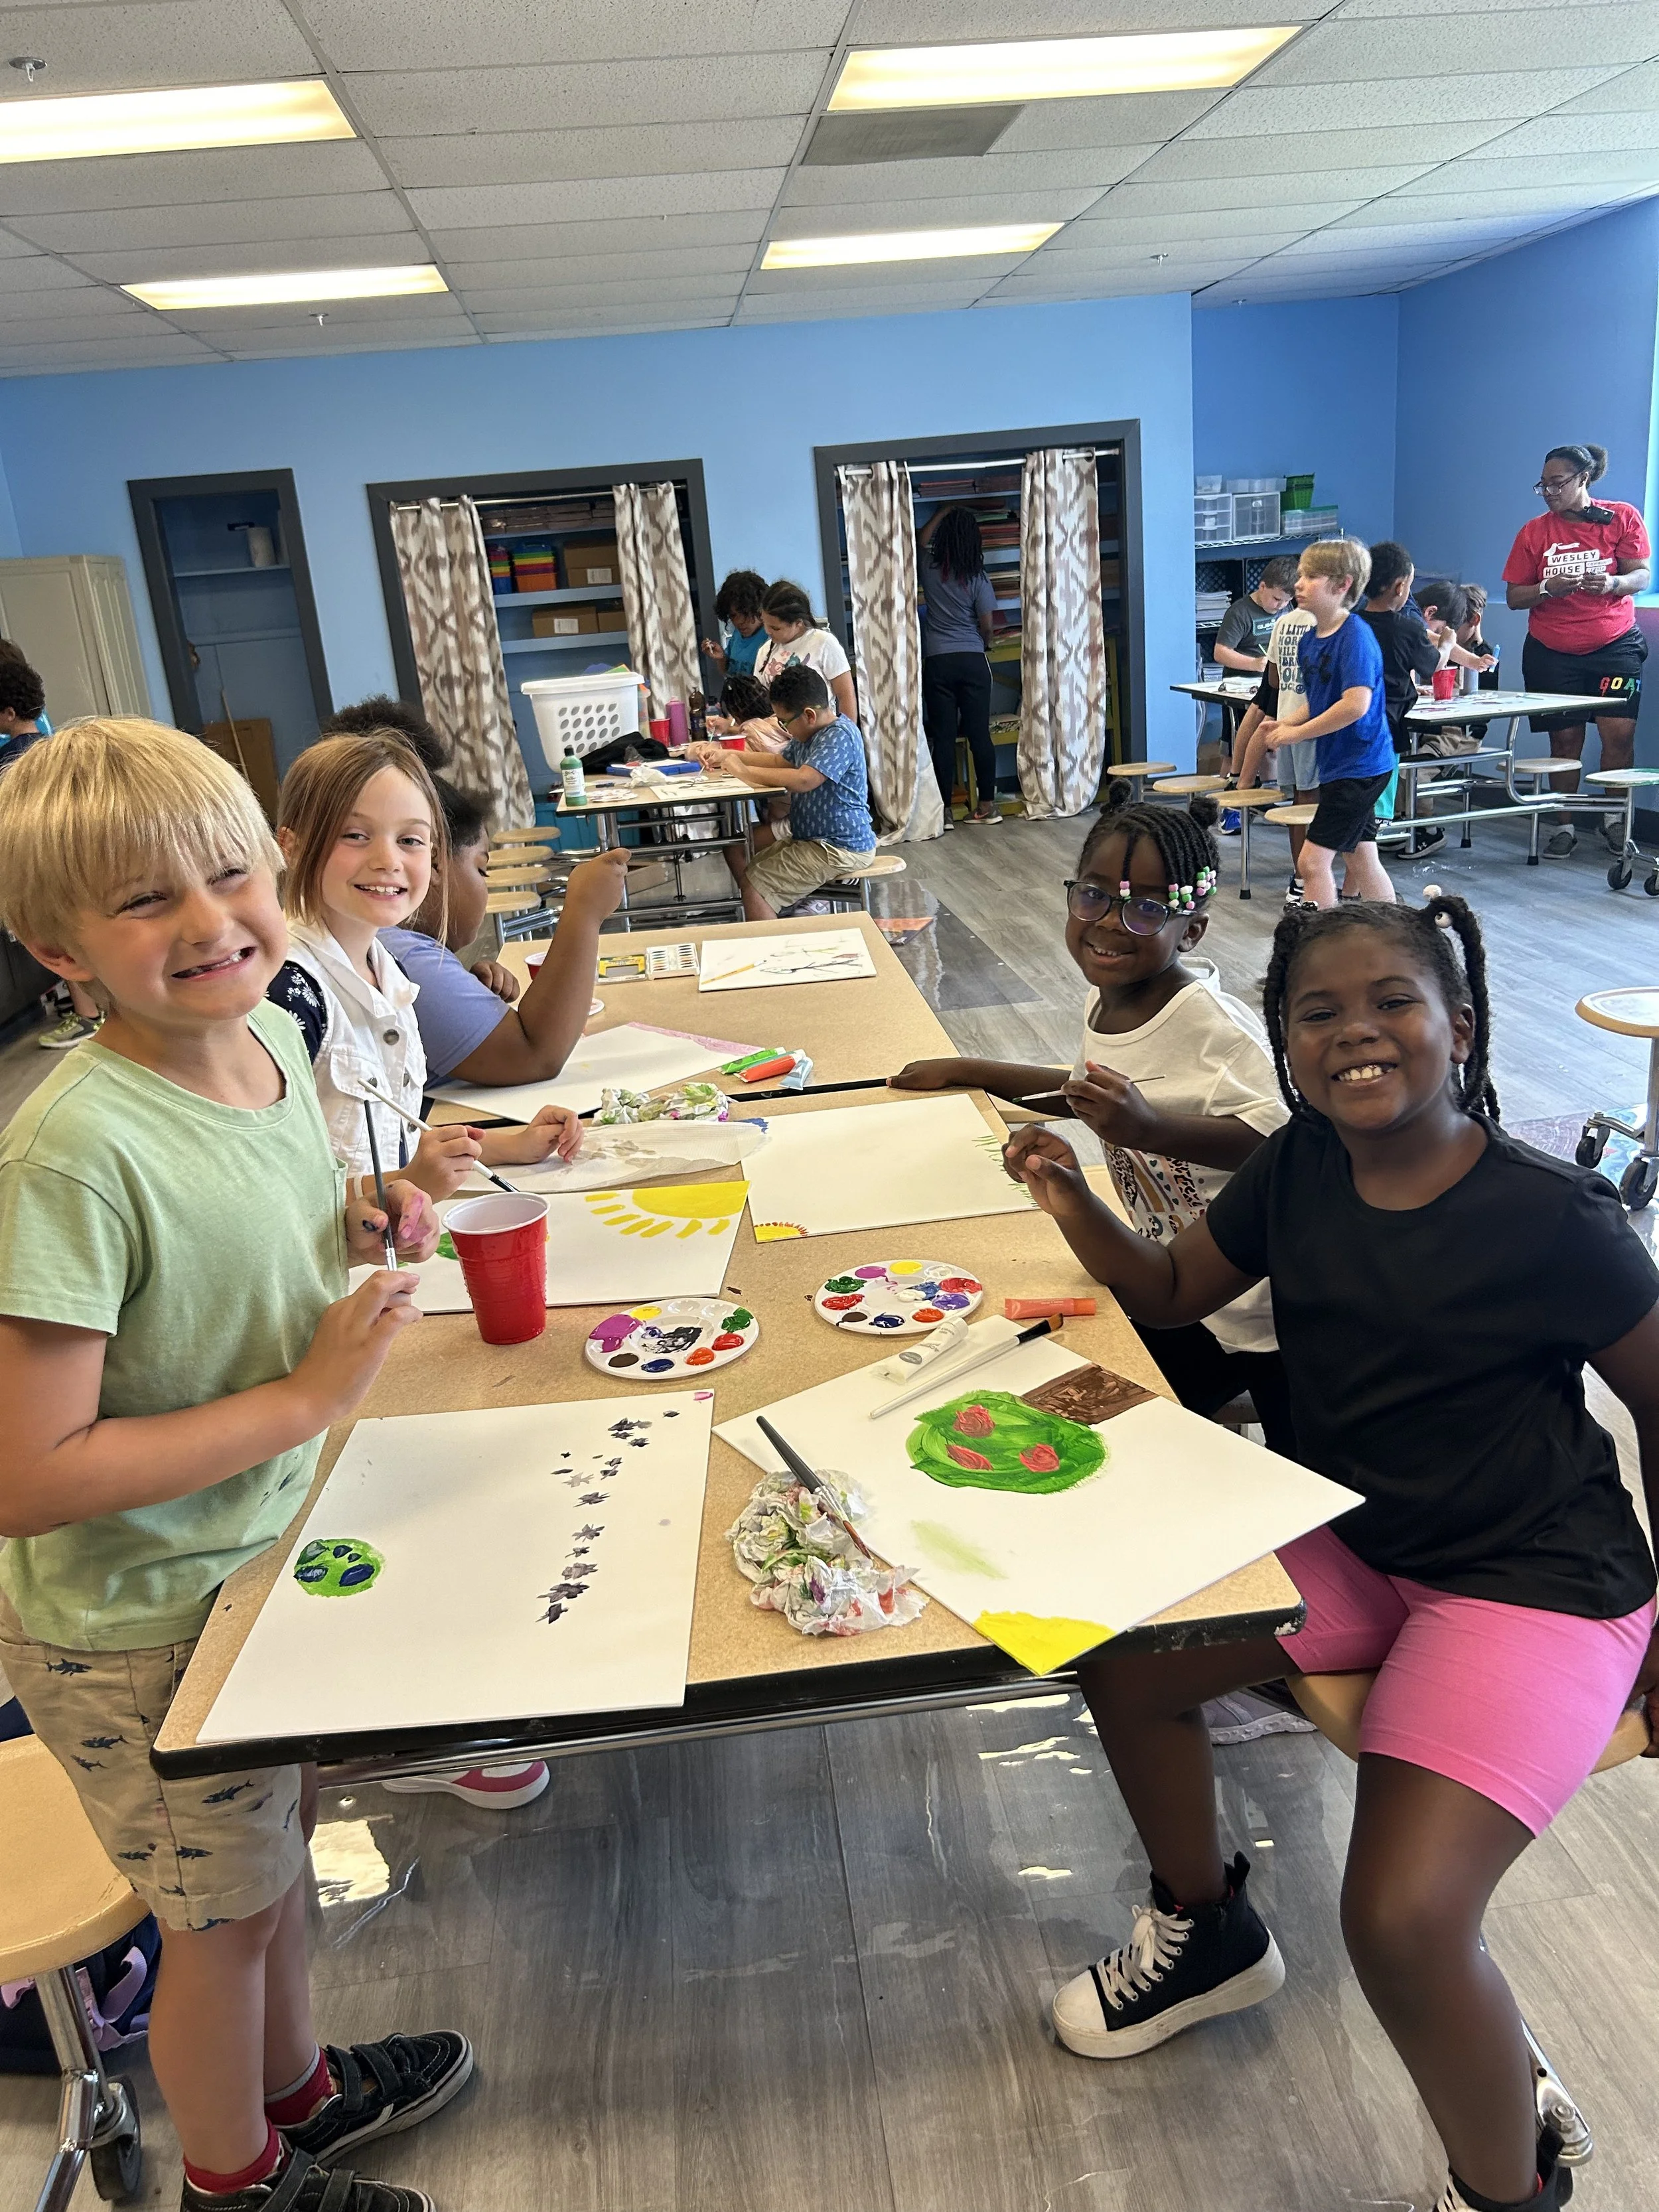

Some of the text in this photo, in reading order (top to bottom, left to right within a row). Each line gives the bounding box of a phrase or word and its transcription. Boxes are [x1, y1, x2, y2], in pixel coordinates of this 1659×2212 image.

[1551, 551, 1596, 563] WESLEY
[1546, 565, 1580, 576] HOUSE
[1599, 676, 1641, 696] GOAT
